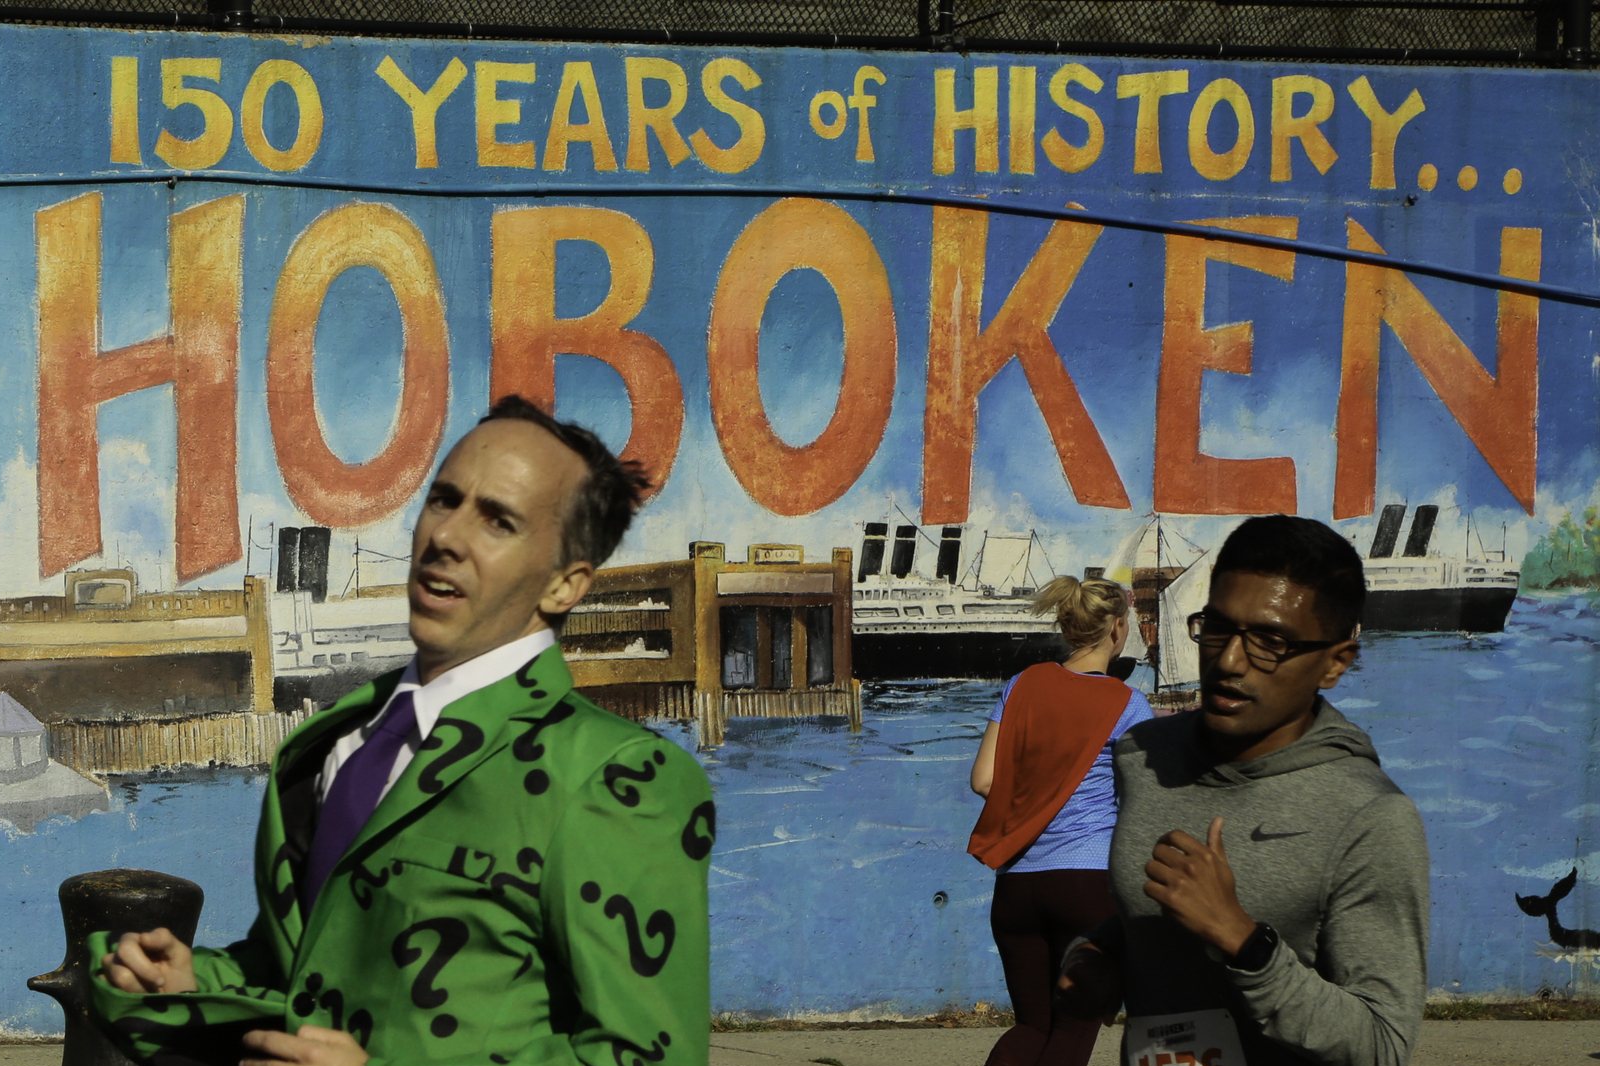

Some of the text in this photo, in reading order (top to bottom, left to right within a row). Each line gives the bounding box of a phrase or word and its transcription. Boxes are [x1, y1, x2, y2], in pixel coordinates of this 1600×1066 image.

[110, 56, 324, 172] 150
[375, 55, 766, 175] YEARS
[809, 65, 888, 163] of
[36, 192, 1541, 584] HOBOKEN
